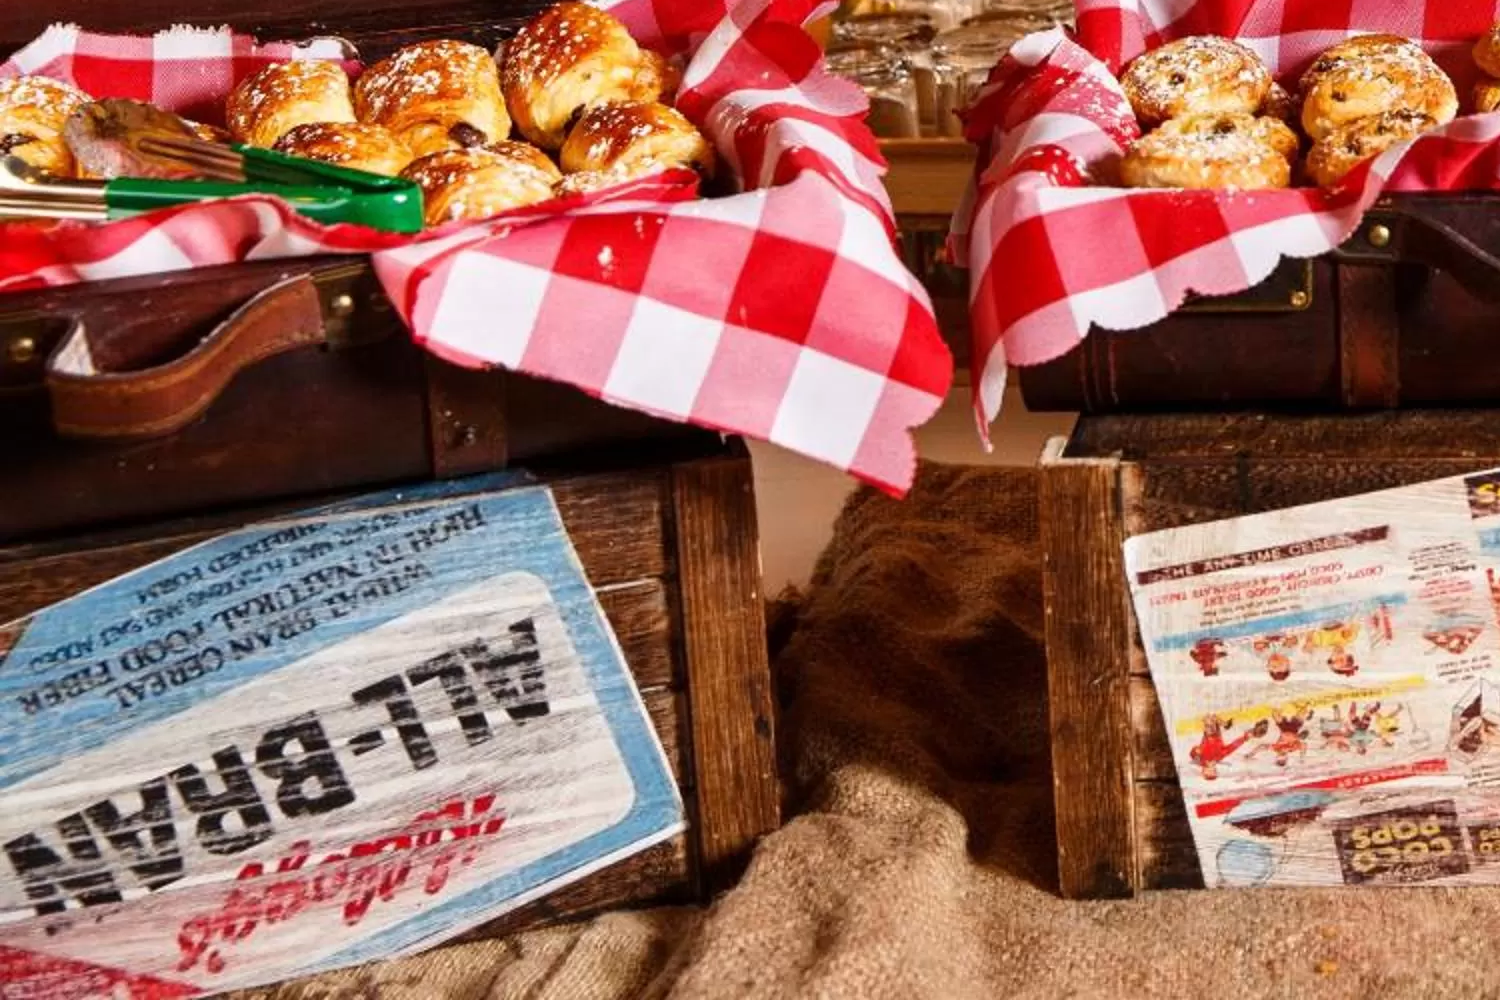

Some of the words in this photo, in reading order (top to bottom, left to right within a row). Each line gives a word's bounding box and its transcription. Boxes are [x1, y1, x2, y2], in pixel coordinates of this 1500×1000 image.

[212, 556, 363, 632] NATURAL
[120, 620, 204, 673] FOOD
[16, 661, 115, 716] FIBER
[105, 647, 225, 709] CEREAL
[1, 618, 550, 926] ALL-BRAN
[1352, 815, 1441, 850] POPS
[1352, 837, 1453, 874] COCO
